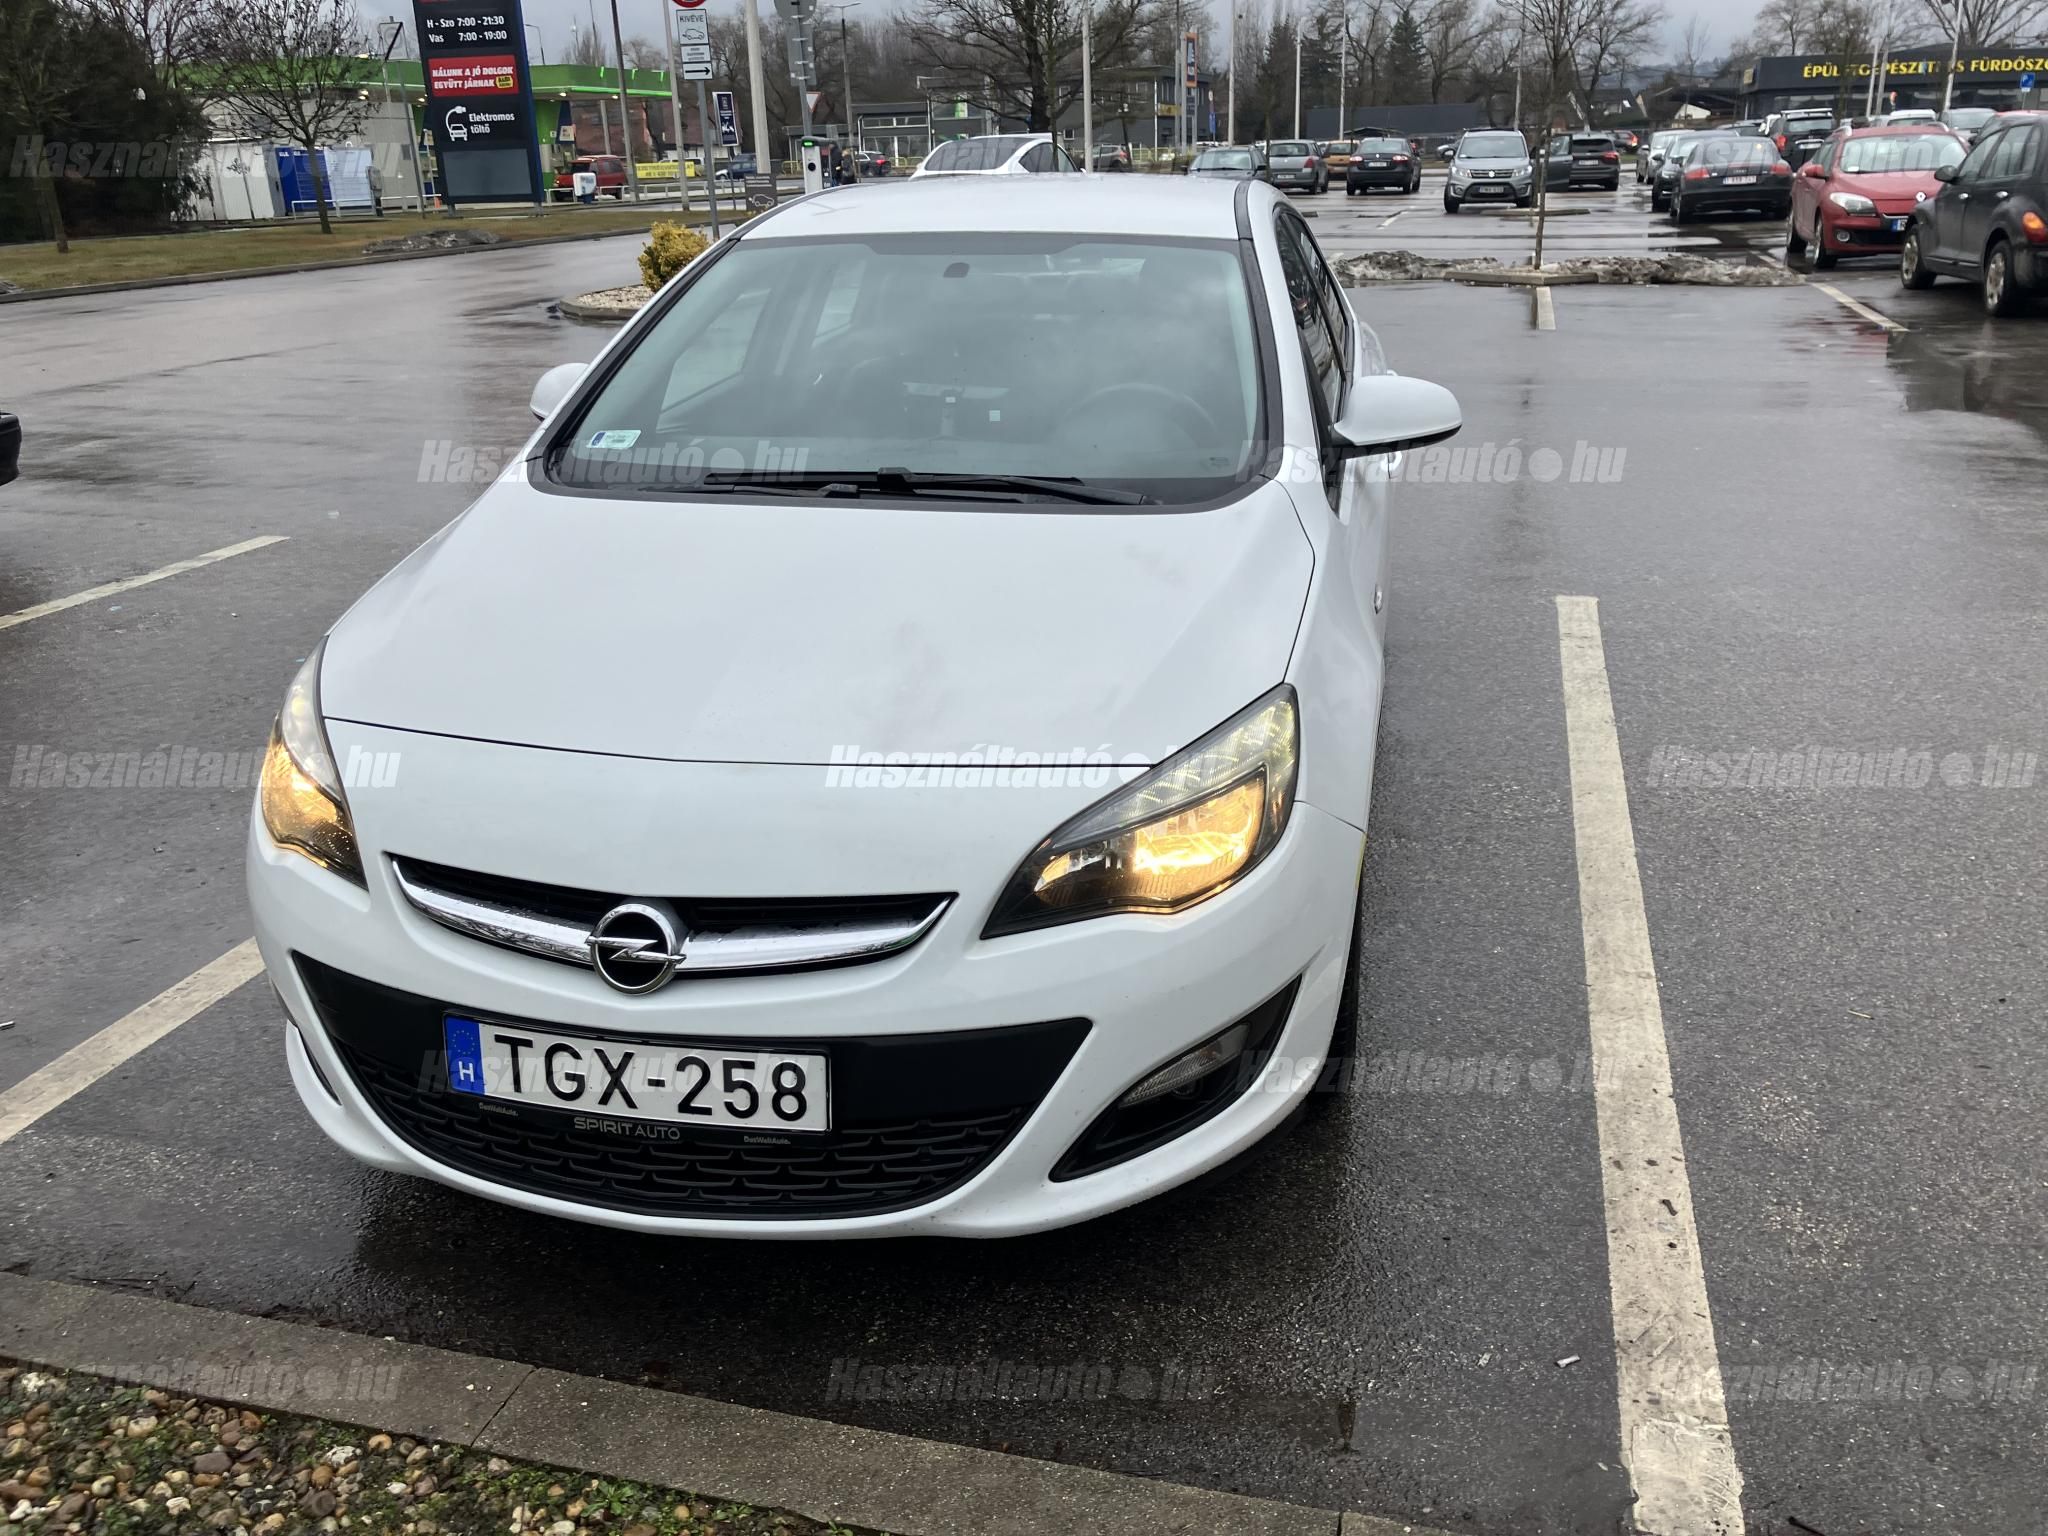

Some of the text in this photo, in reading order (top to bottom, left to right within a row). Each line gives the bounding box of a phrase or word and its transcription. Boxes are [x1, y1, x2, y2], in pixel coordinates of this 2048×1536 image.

[426, 19, 434, 28] H
[440, 18, 455, 28] Szo
[456, 17, 476, 27] 7:00
[482, 15, 505, 25] 21:30
[428, 34, 444, 43] Vas
[458, 32, 478, 41] 7:00
[483, 30, 508, 40] 19:00
[1970, 56, 2048, 72] FÜRDŐSZ
[432, 65, 514, 77] NÁLUNK A JÓ DOLGOK
[434, 79, 462, 89] EGYÜTT
[464, 77, 495, 89] JÁRNAK
[469, 112, 515, 122] Elektromos
[470, 123, 491, 134] töltő
[458, 1033, 807, 1122] H TGX-258
[574, 1116, 681, 1140] SPIRIT AUTO
